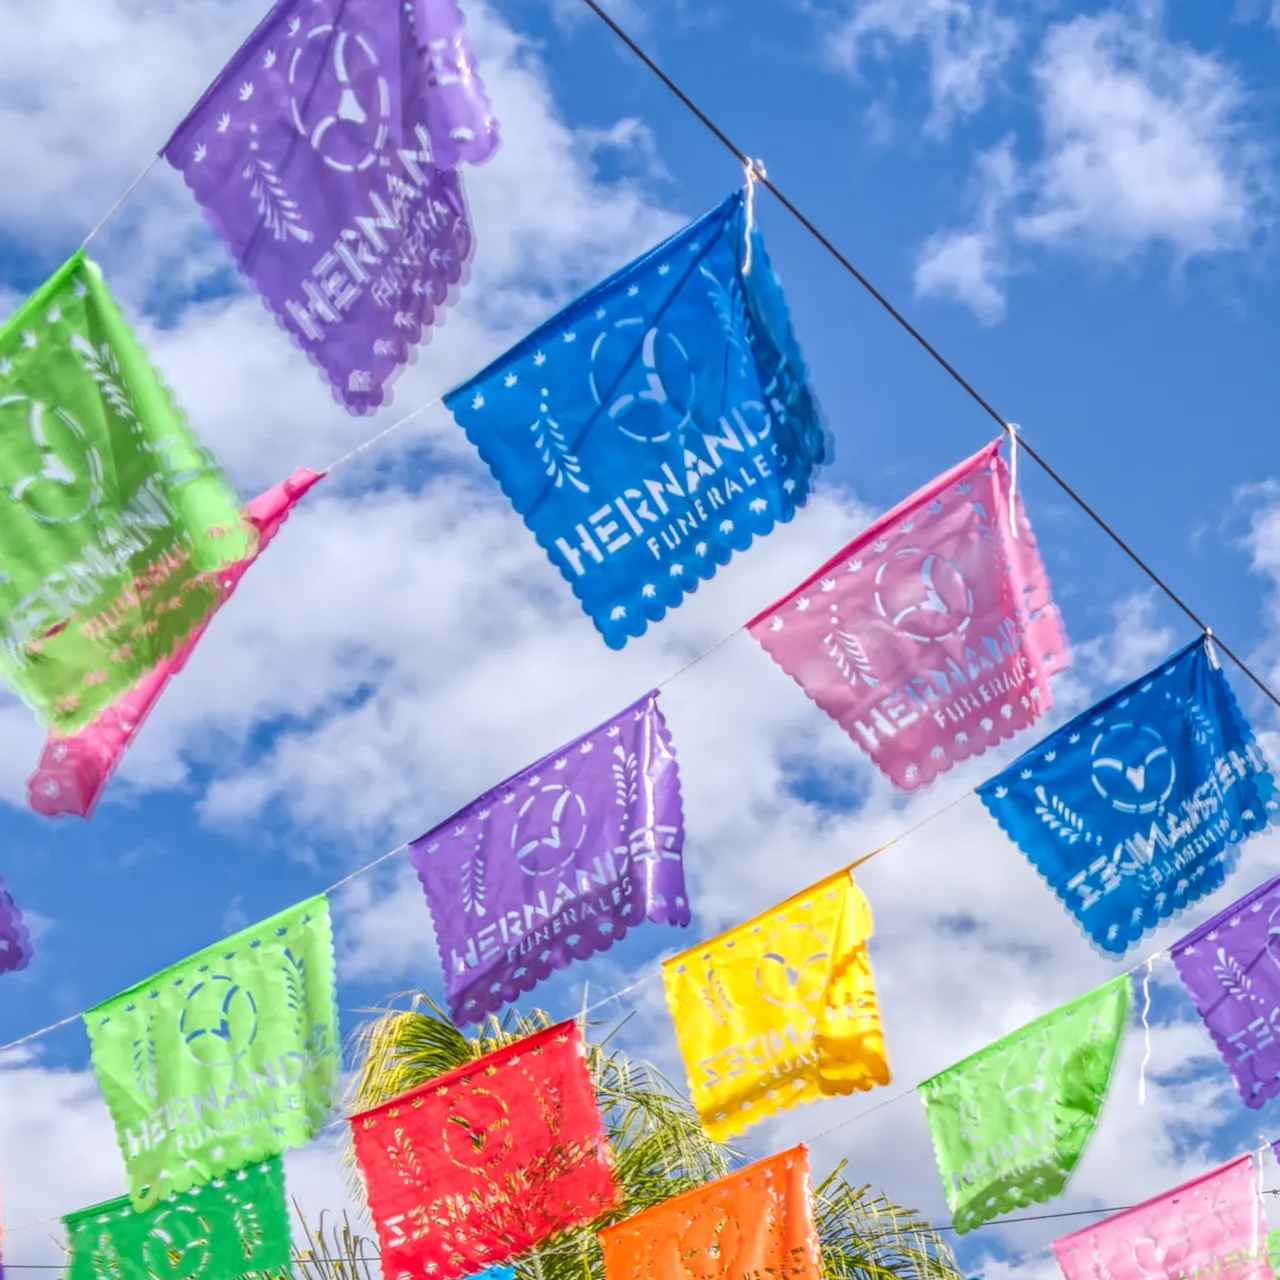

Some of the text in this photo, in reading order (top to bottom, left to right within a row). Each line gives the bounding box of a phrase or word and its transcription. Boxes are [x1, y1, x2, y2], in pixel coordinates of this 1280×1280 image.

[285, 123, 435, 342] HERNAN
[853, 616, 1021, 747] HERNAN
[450, 825, 681, 977] HERNANDEZ
[506, 876, 633, 965] FUNERALES
